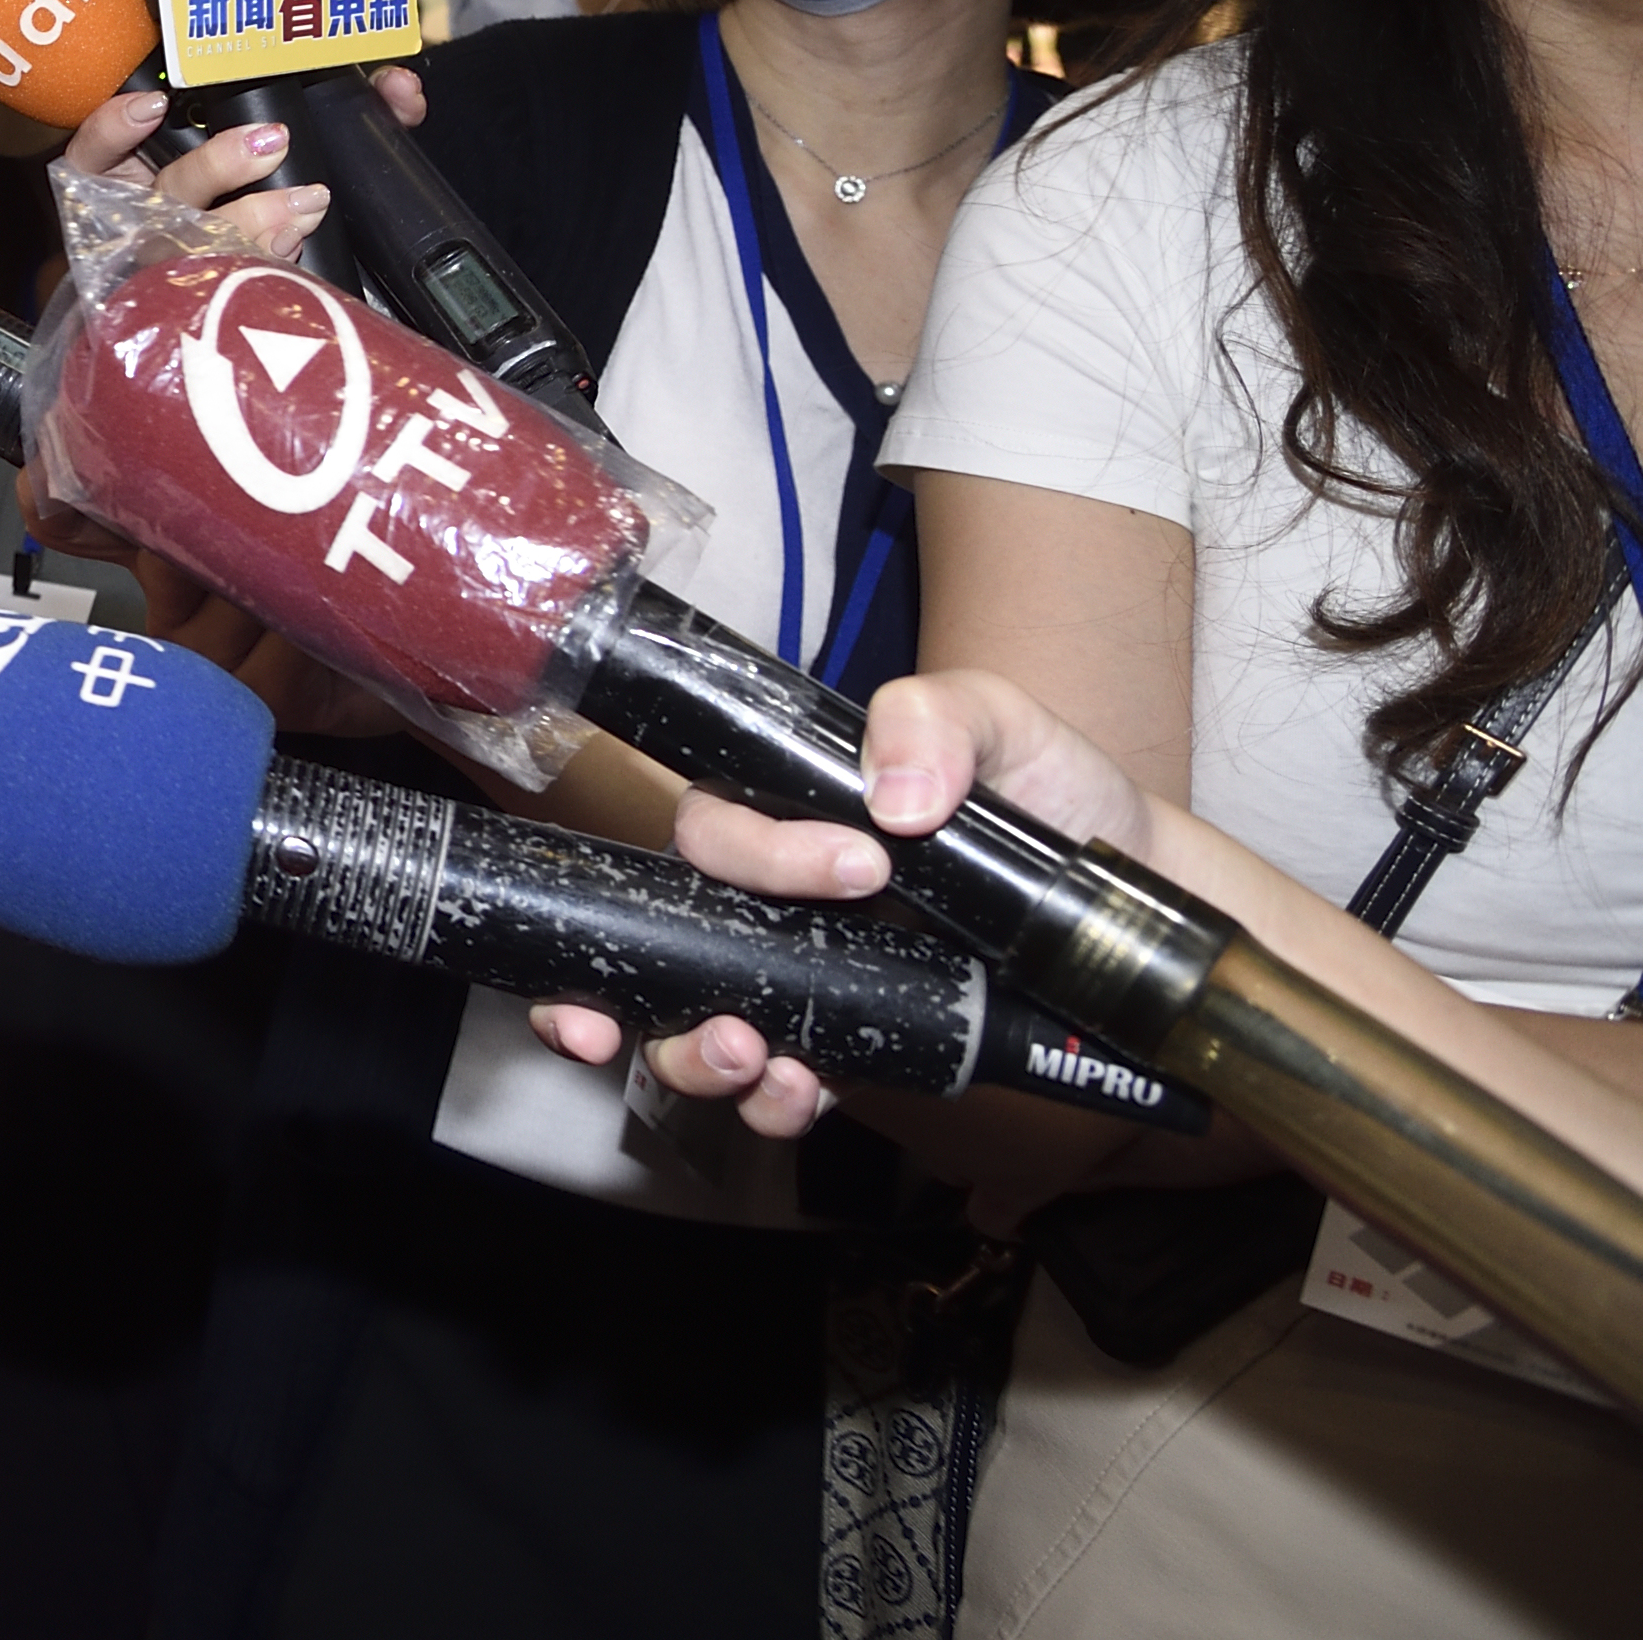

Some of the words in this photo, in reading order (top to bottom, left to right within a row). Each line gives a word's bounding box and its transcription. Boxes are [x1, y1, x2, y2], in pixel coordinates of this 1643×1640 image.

[187, 40, 251, 58] CHANNEL
[261, 36, 276, 49] 51
[324, 369, 511, 585] TTV
